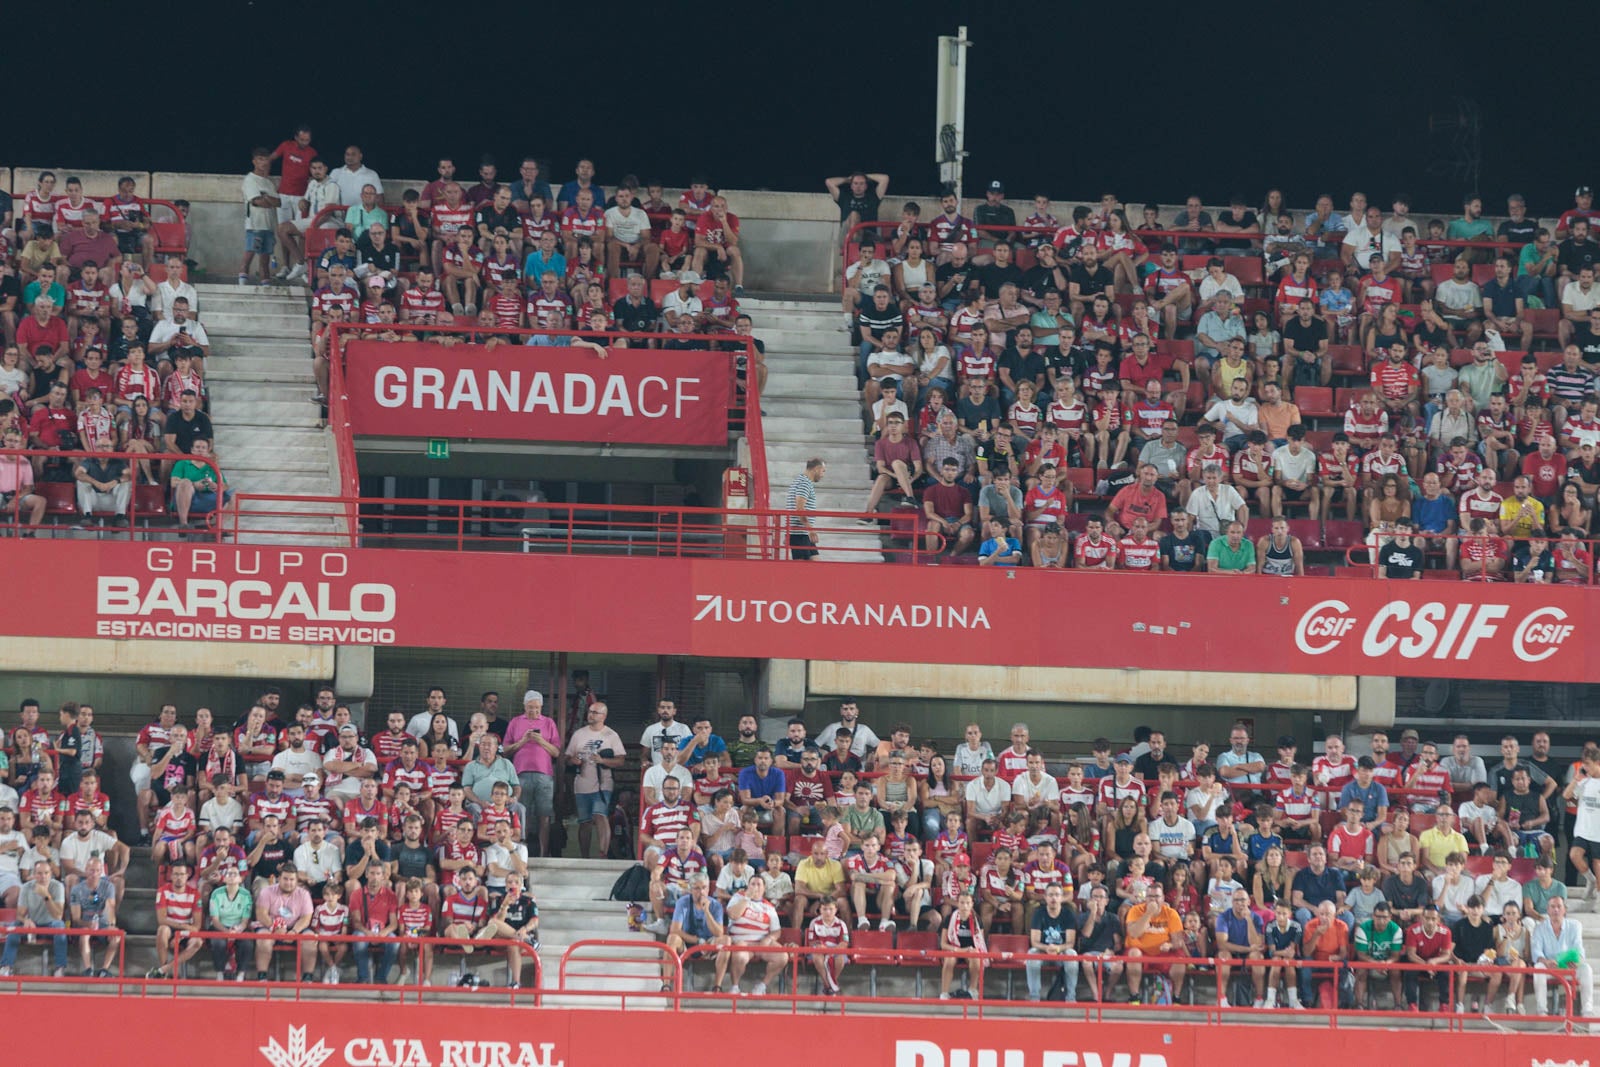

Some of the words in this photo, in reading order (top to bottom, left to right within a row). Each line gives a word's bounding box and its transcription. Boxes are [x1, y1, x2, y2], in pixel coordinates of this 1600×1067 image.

[147, 547, 350, 578] GRUPO
[97, 576, 397, 623] BARCALO
[693, 594, 991, 630] AUTOGRANADINA
[96, 620, 243, 639] ESTACIONES
[250, 624, 281, 641] DE
[287, 625, 396, 644] SERVICIO
[1307, 616, 1357, 637] CSIF
[1362, 600, 1510, 660] CSIF
[1525, 622, 1575, 644] CSIF
[343, 1037, 433, 1067] CAJA
[440, 1039, 565, 1067] RURAL
